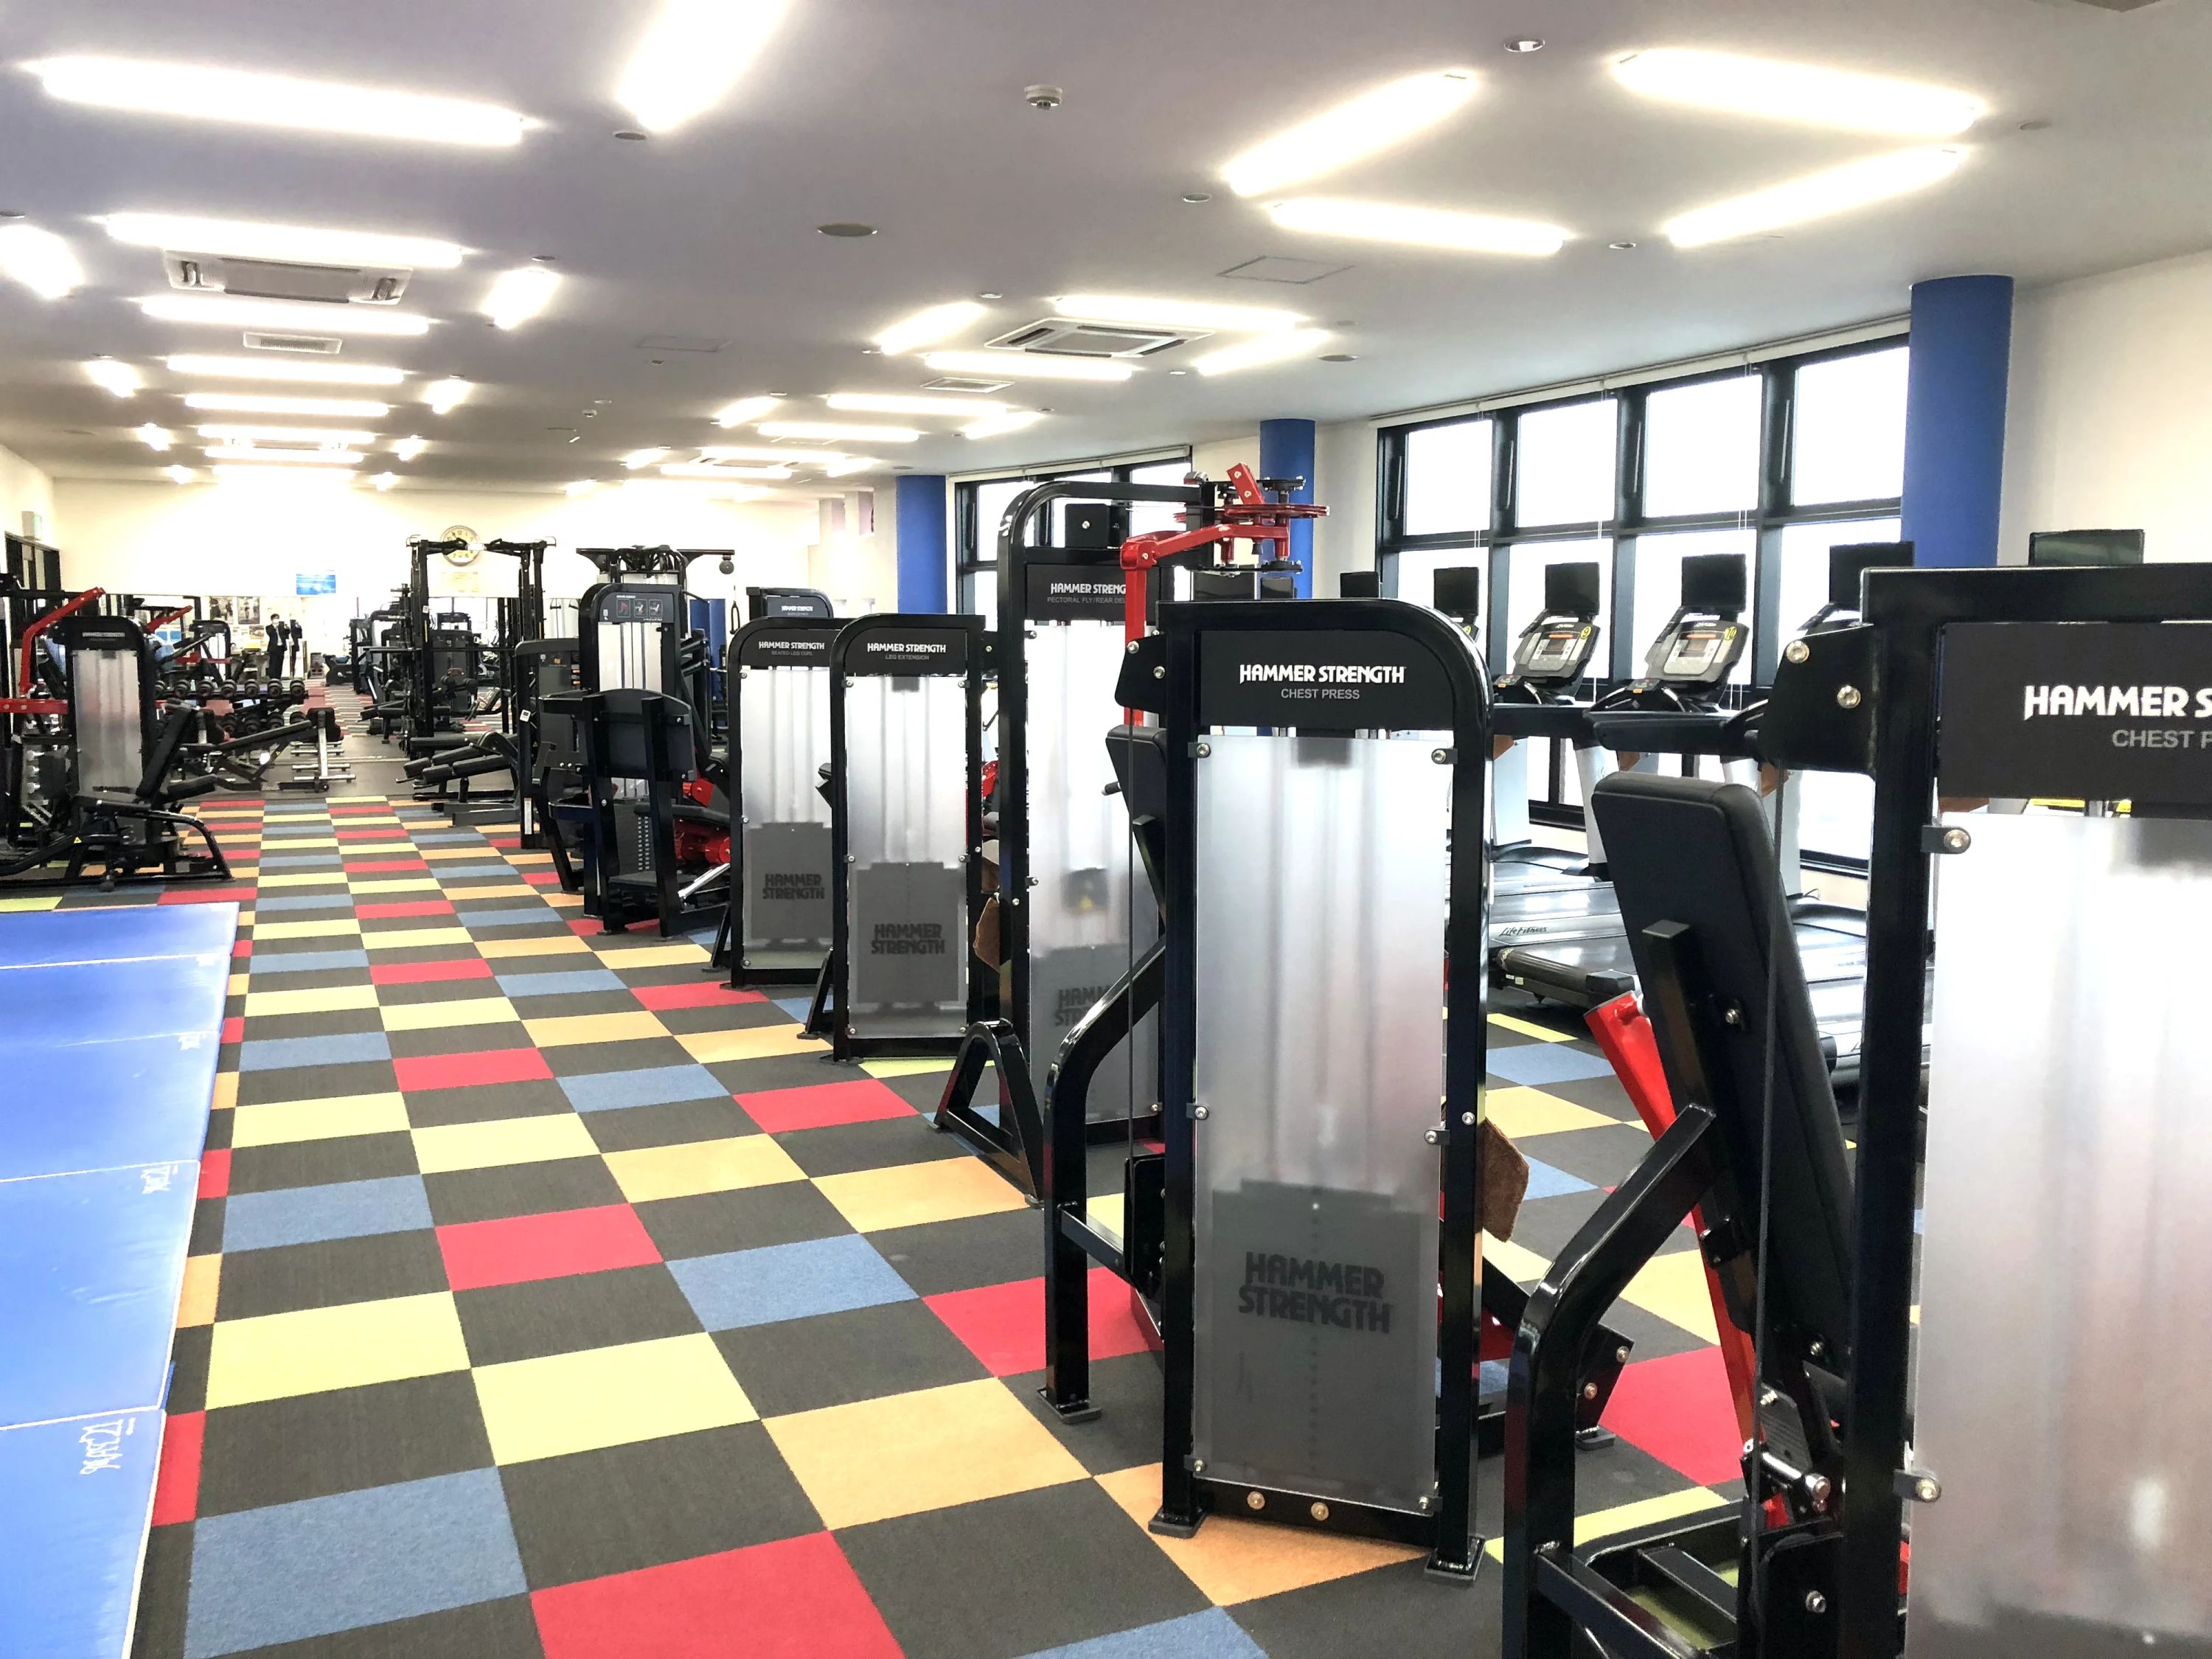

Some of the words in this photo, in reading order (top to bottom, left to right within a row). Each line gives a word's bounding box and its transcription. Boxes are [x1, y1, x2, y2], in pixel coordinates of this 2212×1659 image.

[1050, 582, 1091, 594] HAMMER
[1093, 583, 1127, 594] STRENG
[759, 641, 790, 649] HAMMER
[790, 641, 825, 650] STRENGTH
[867, 643, 905, 653] HAMMER
[905, 644, 947, 653] STRENGTH
[1239, 664, 1316, 684] HAMMER
[1318, 665, 1405, 684] STRENGTH
[1281, 688, 1319, 699] CHEST
[1321, 689, 1360, 700] PRESS
[2024, 685, 2190, 721] HAMMER
[2112, 729, 2195, 748] CHEST
[765, 873, 822, 887] HAMMER
[762, 887, 826, 900] STRENGTH
[874, 923, 943, 939] HAMMER
[871, 939, 946, 955] STRENGTH
[1245, 1251, 1385, 1299] HAMMER
[1238, 1284, 1394, 1334] STRENGTH
